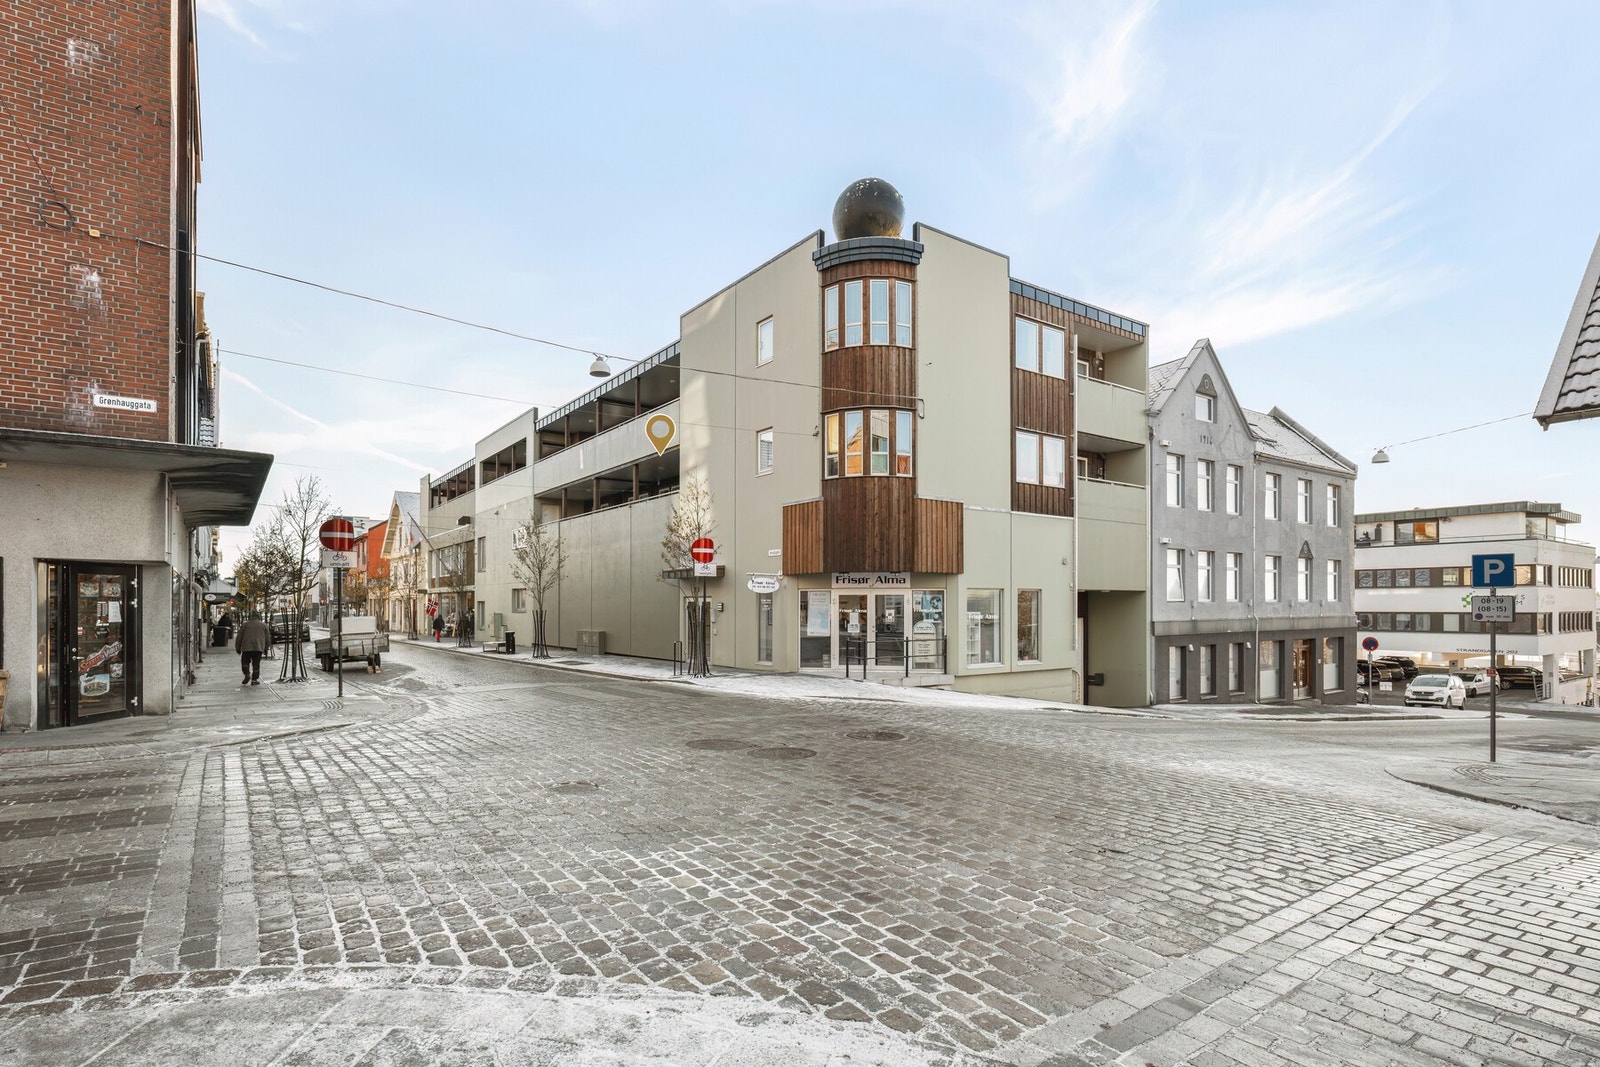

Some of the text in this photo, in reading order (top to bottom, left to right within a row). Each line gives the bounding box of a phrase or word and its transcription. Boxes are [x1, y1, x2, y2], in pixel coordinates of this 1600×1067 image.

[98, 396, 152, 410] Grønhauggata
[1483, 559, 1505, 584] P
[835, 575, 906, 585] Frisør Alma
